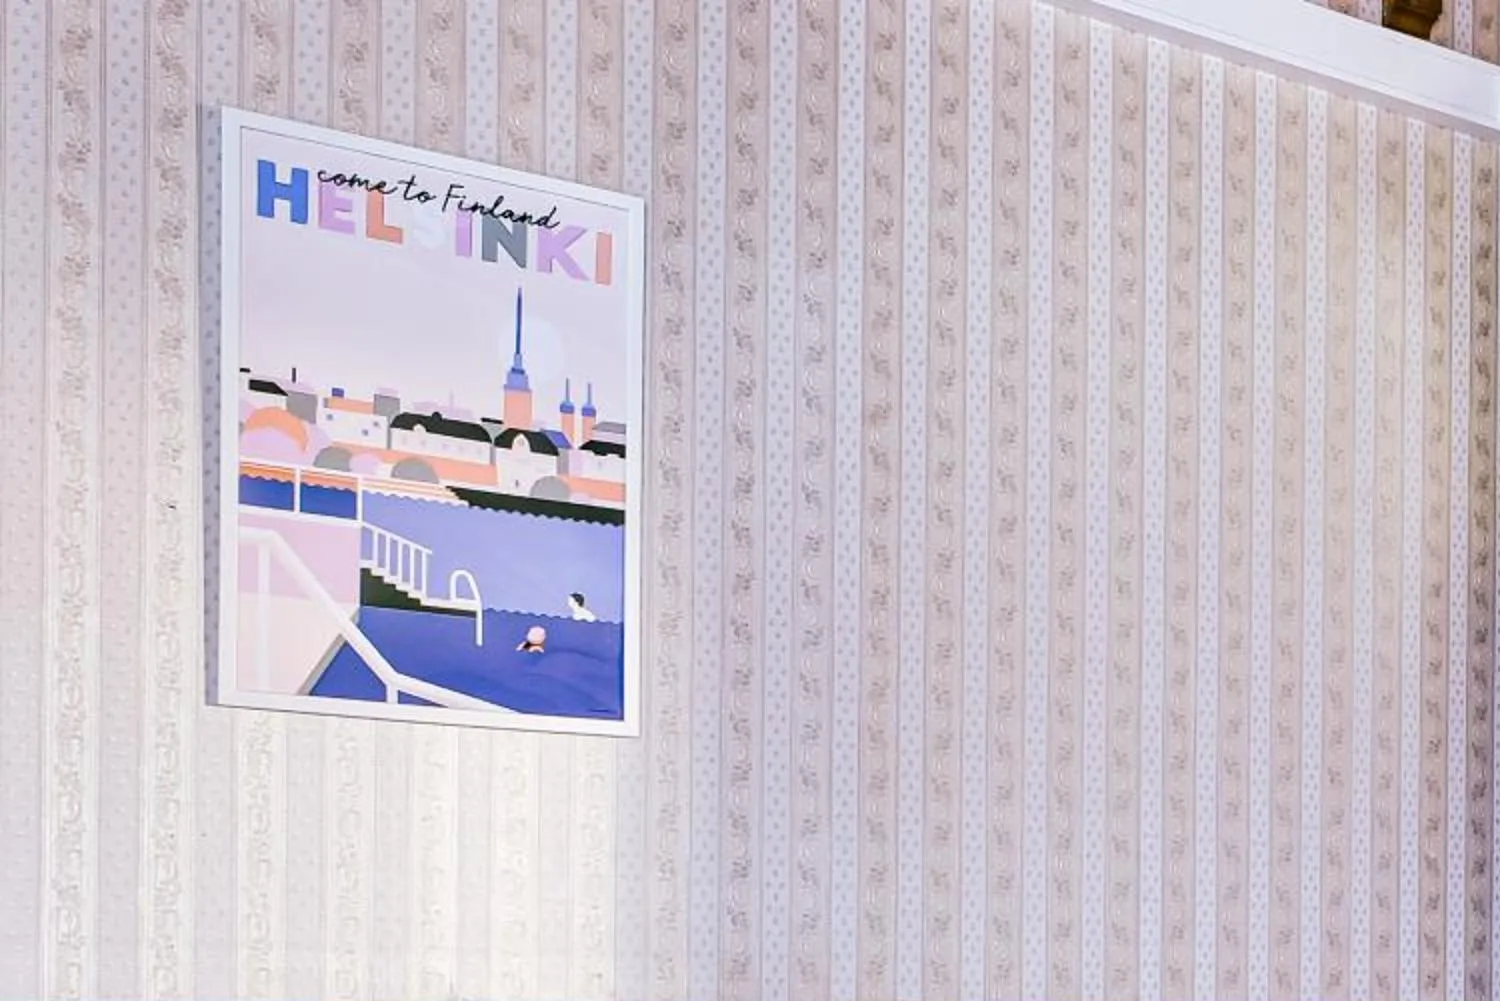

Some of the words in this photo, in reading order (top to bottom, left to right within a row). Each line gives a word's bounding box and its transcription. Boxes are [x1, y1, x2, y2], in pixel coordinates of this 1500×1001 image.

[256, 159, 613, 287] HELSINKI
[317, 162, 397, 196] come
[399, 176, 437, 210] to
[442, 184, 560, 231] Finland
